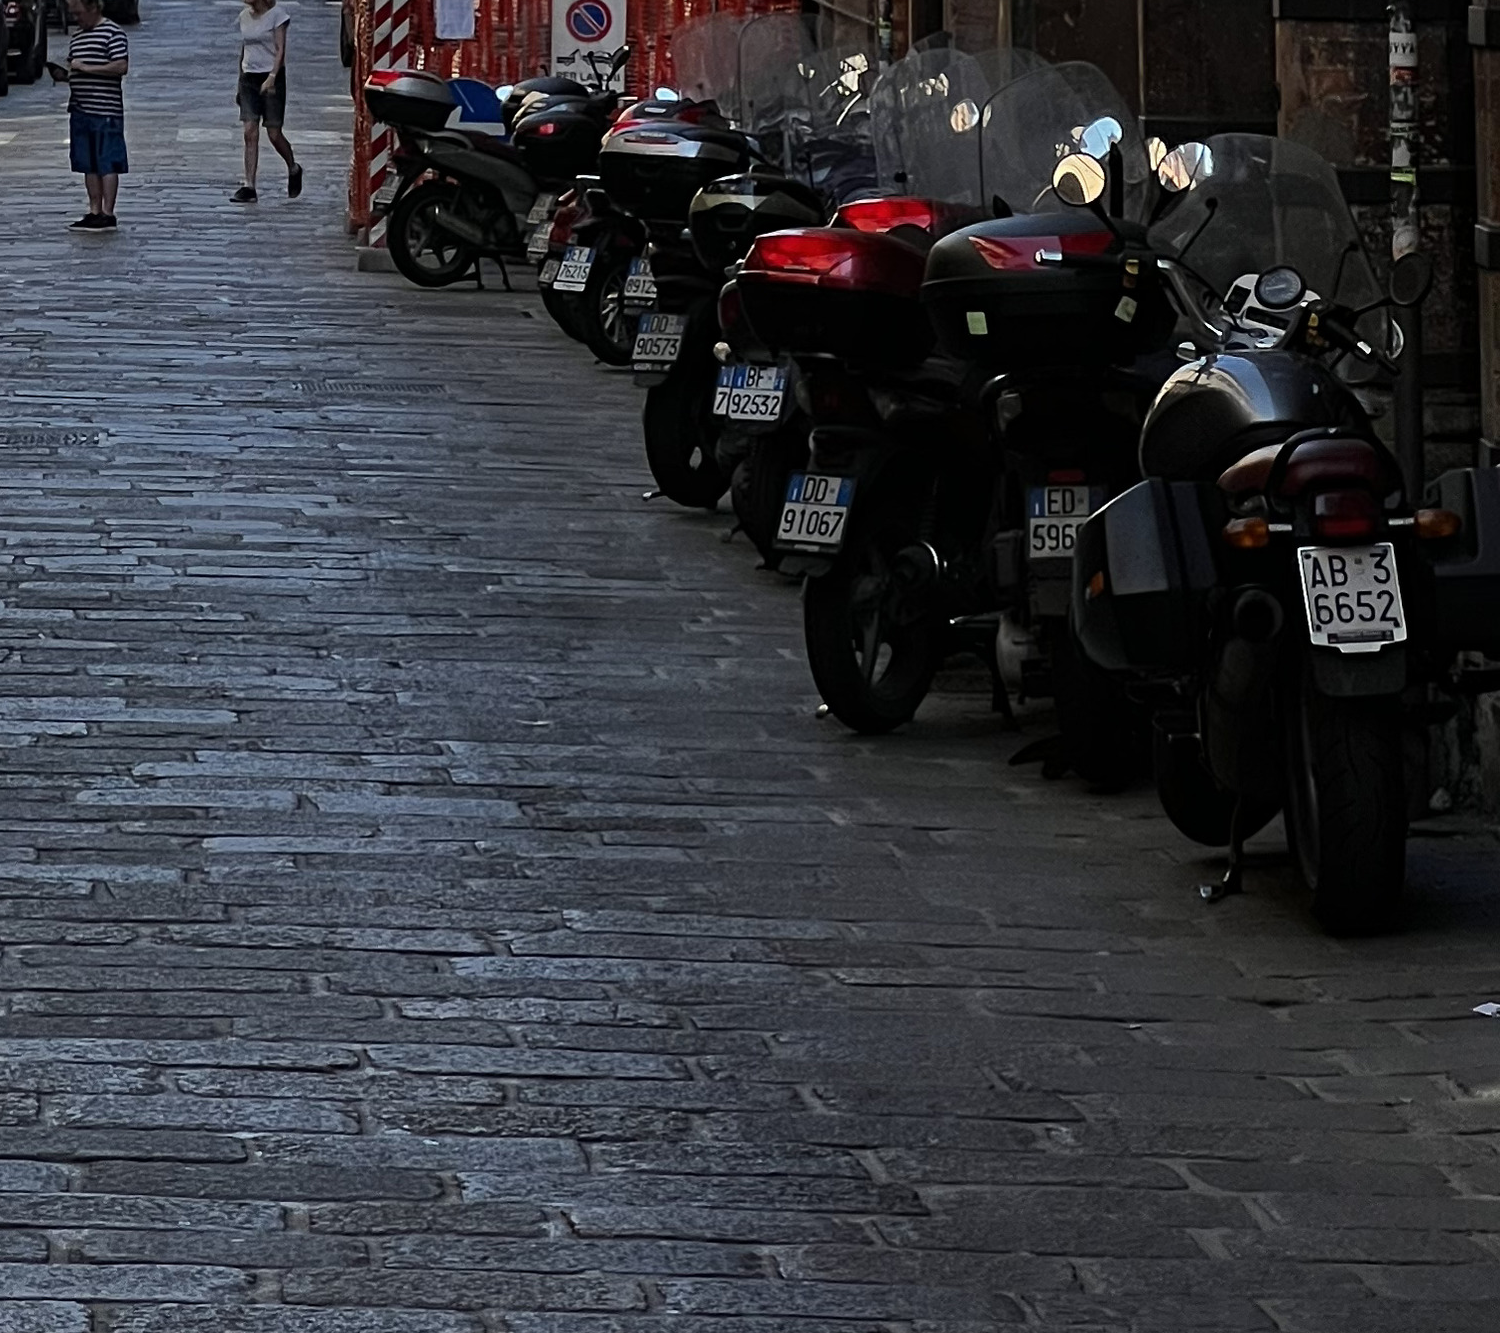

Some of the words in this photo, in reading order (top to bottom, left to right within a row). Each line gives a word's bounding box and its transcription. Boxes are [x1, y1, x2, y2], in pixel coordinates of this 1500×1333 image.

[636, 338, 679, 356] 90573
[747, 367, 767, 387] BF
[731, 394, 781, 416] 92532
[802, 477, 829, 502] DD
[1047, 488, 1075, 515] ED
[782, 508, 844, 538] 91067
[1311, 554, 1349, 589] AB
[1369, 548, 1391, 584] 3
[1313, 590, 1395, 626] 6652
